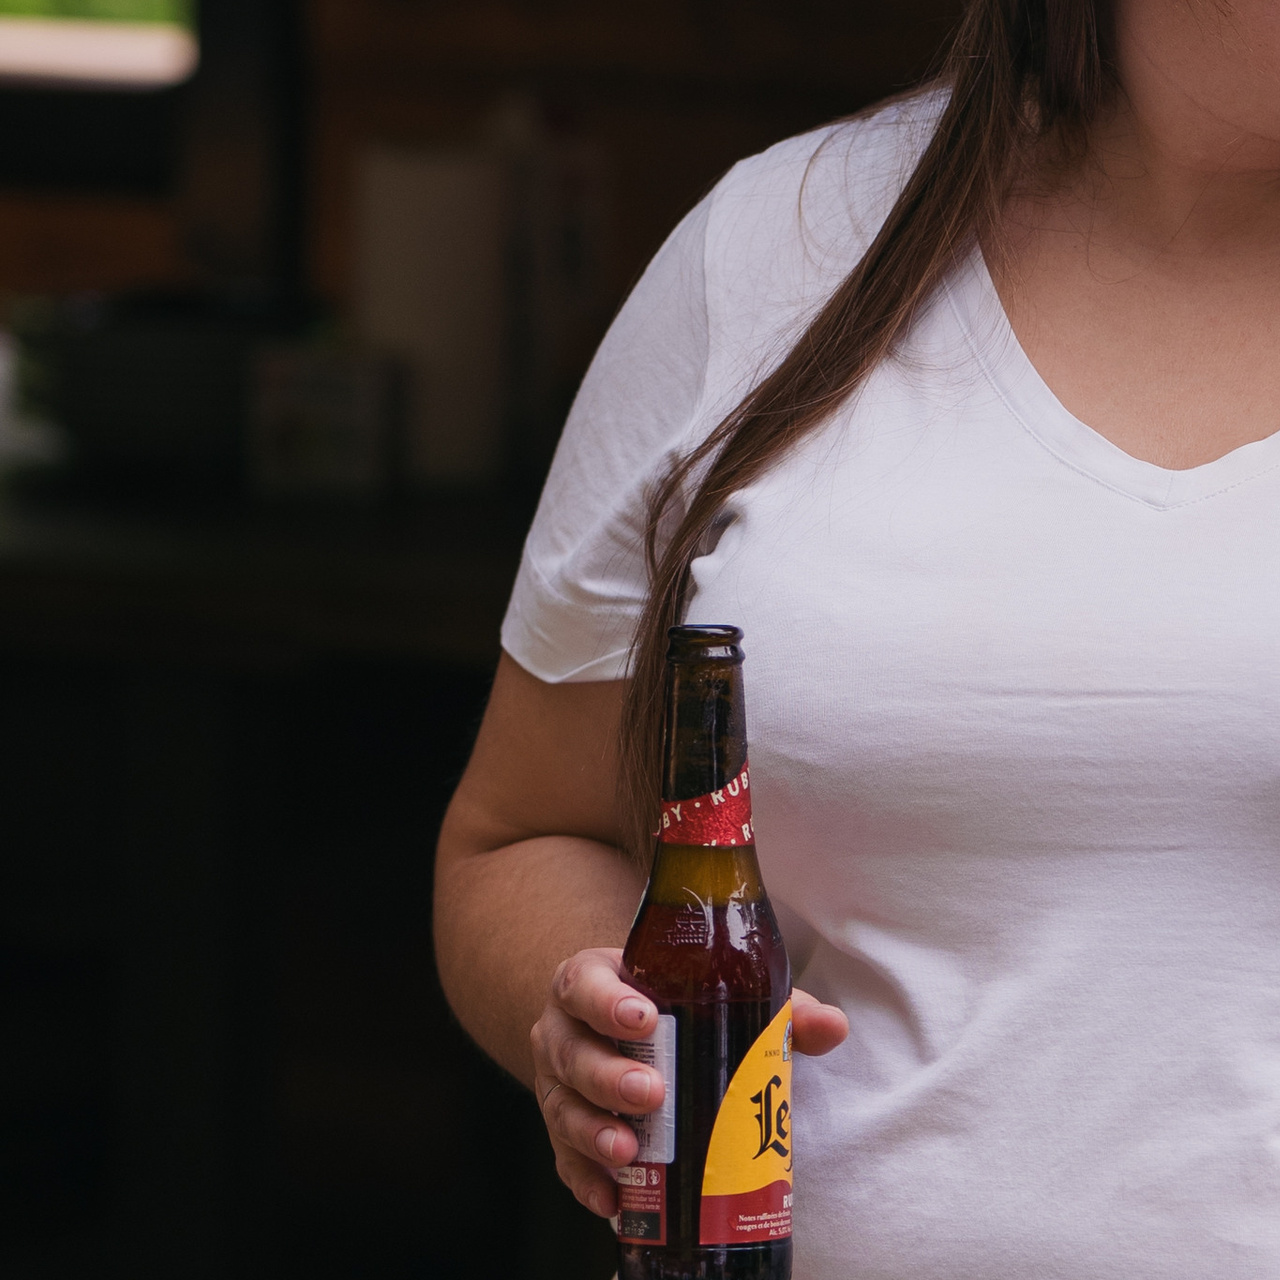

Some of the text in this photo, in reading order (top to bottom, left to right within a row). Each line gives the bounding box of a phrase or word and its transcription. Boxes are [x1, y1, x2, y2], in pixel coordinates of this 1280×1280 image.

[658, 769, 750, 832] BY RUB
[783, 1193, 793, 1209] RU
